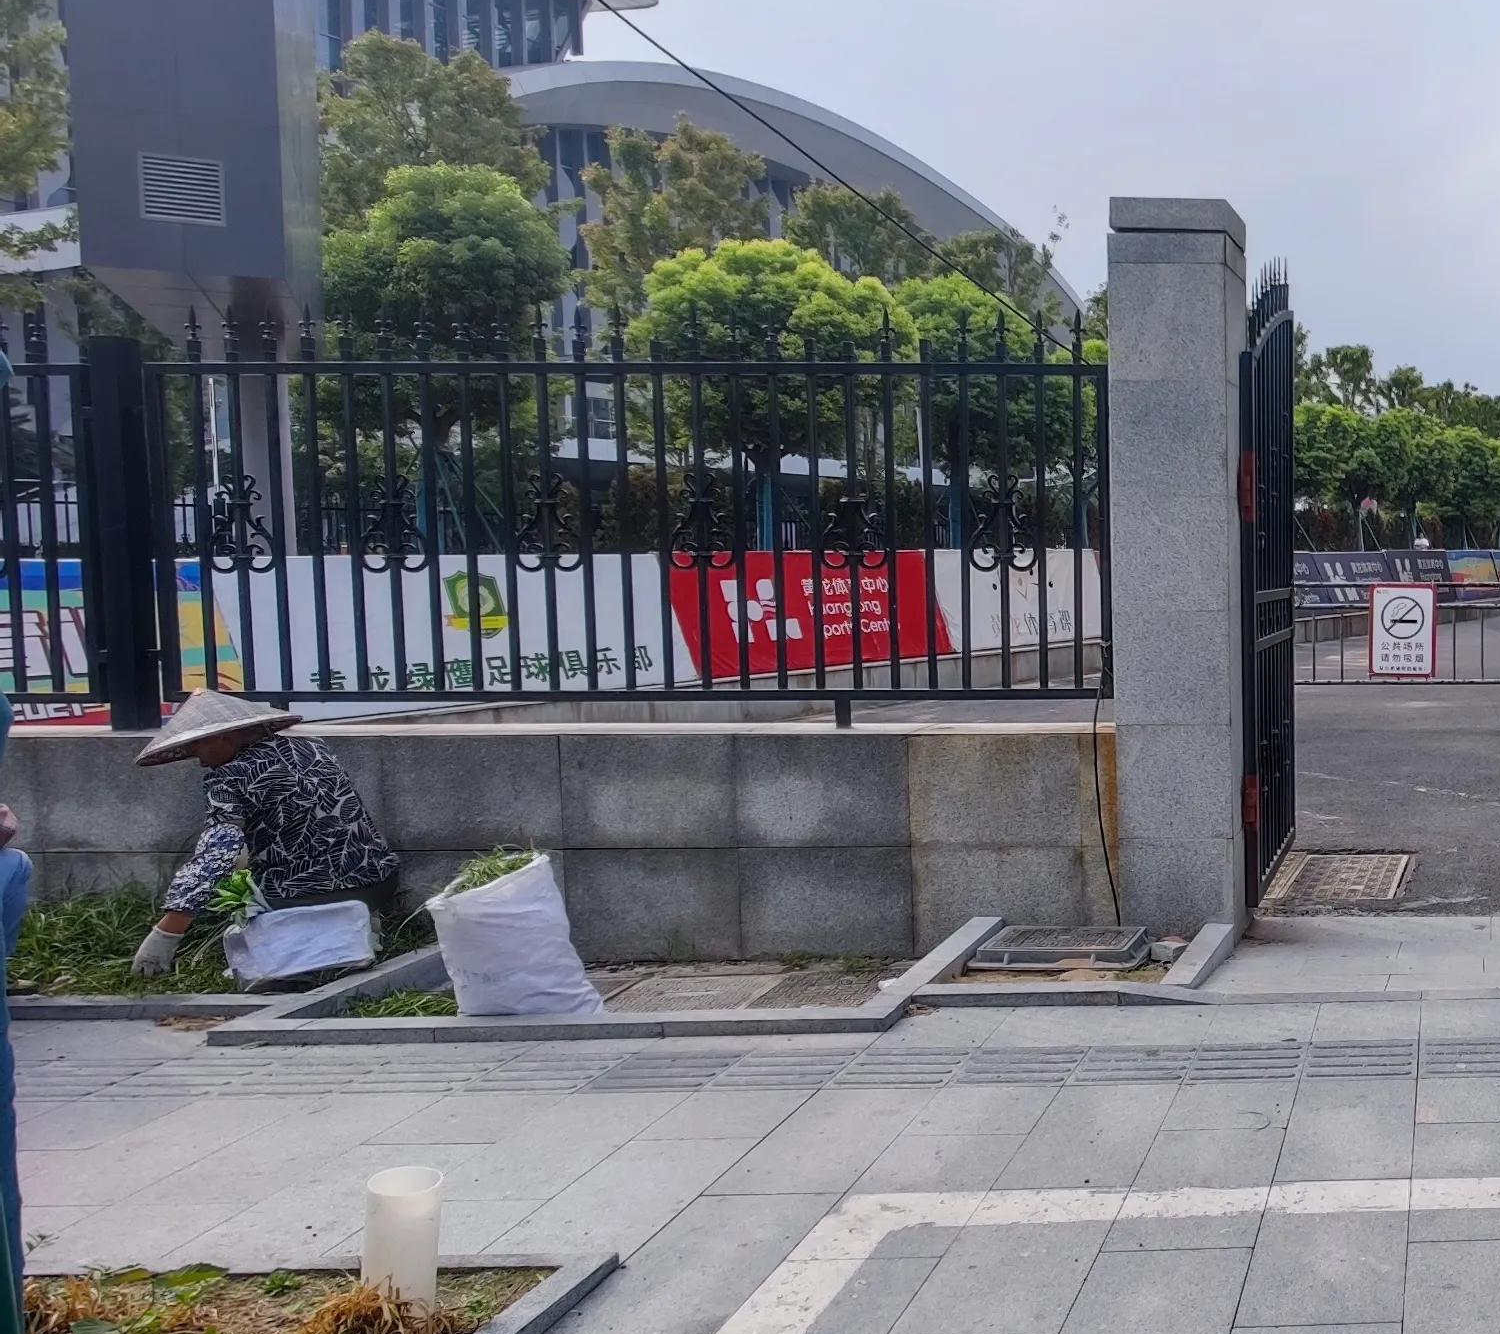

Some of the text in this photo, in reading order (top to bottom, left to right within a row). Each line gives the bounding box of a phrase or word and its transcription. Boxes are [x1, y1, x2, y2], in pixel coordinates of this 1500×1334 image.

[1381, 641, 1425, 652] 公共场所
[1381, 653, 1425, 663] 请勿吸烟
